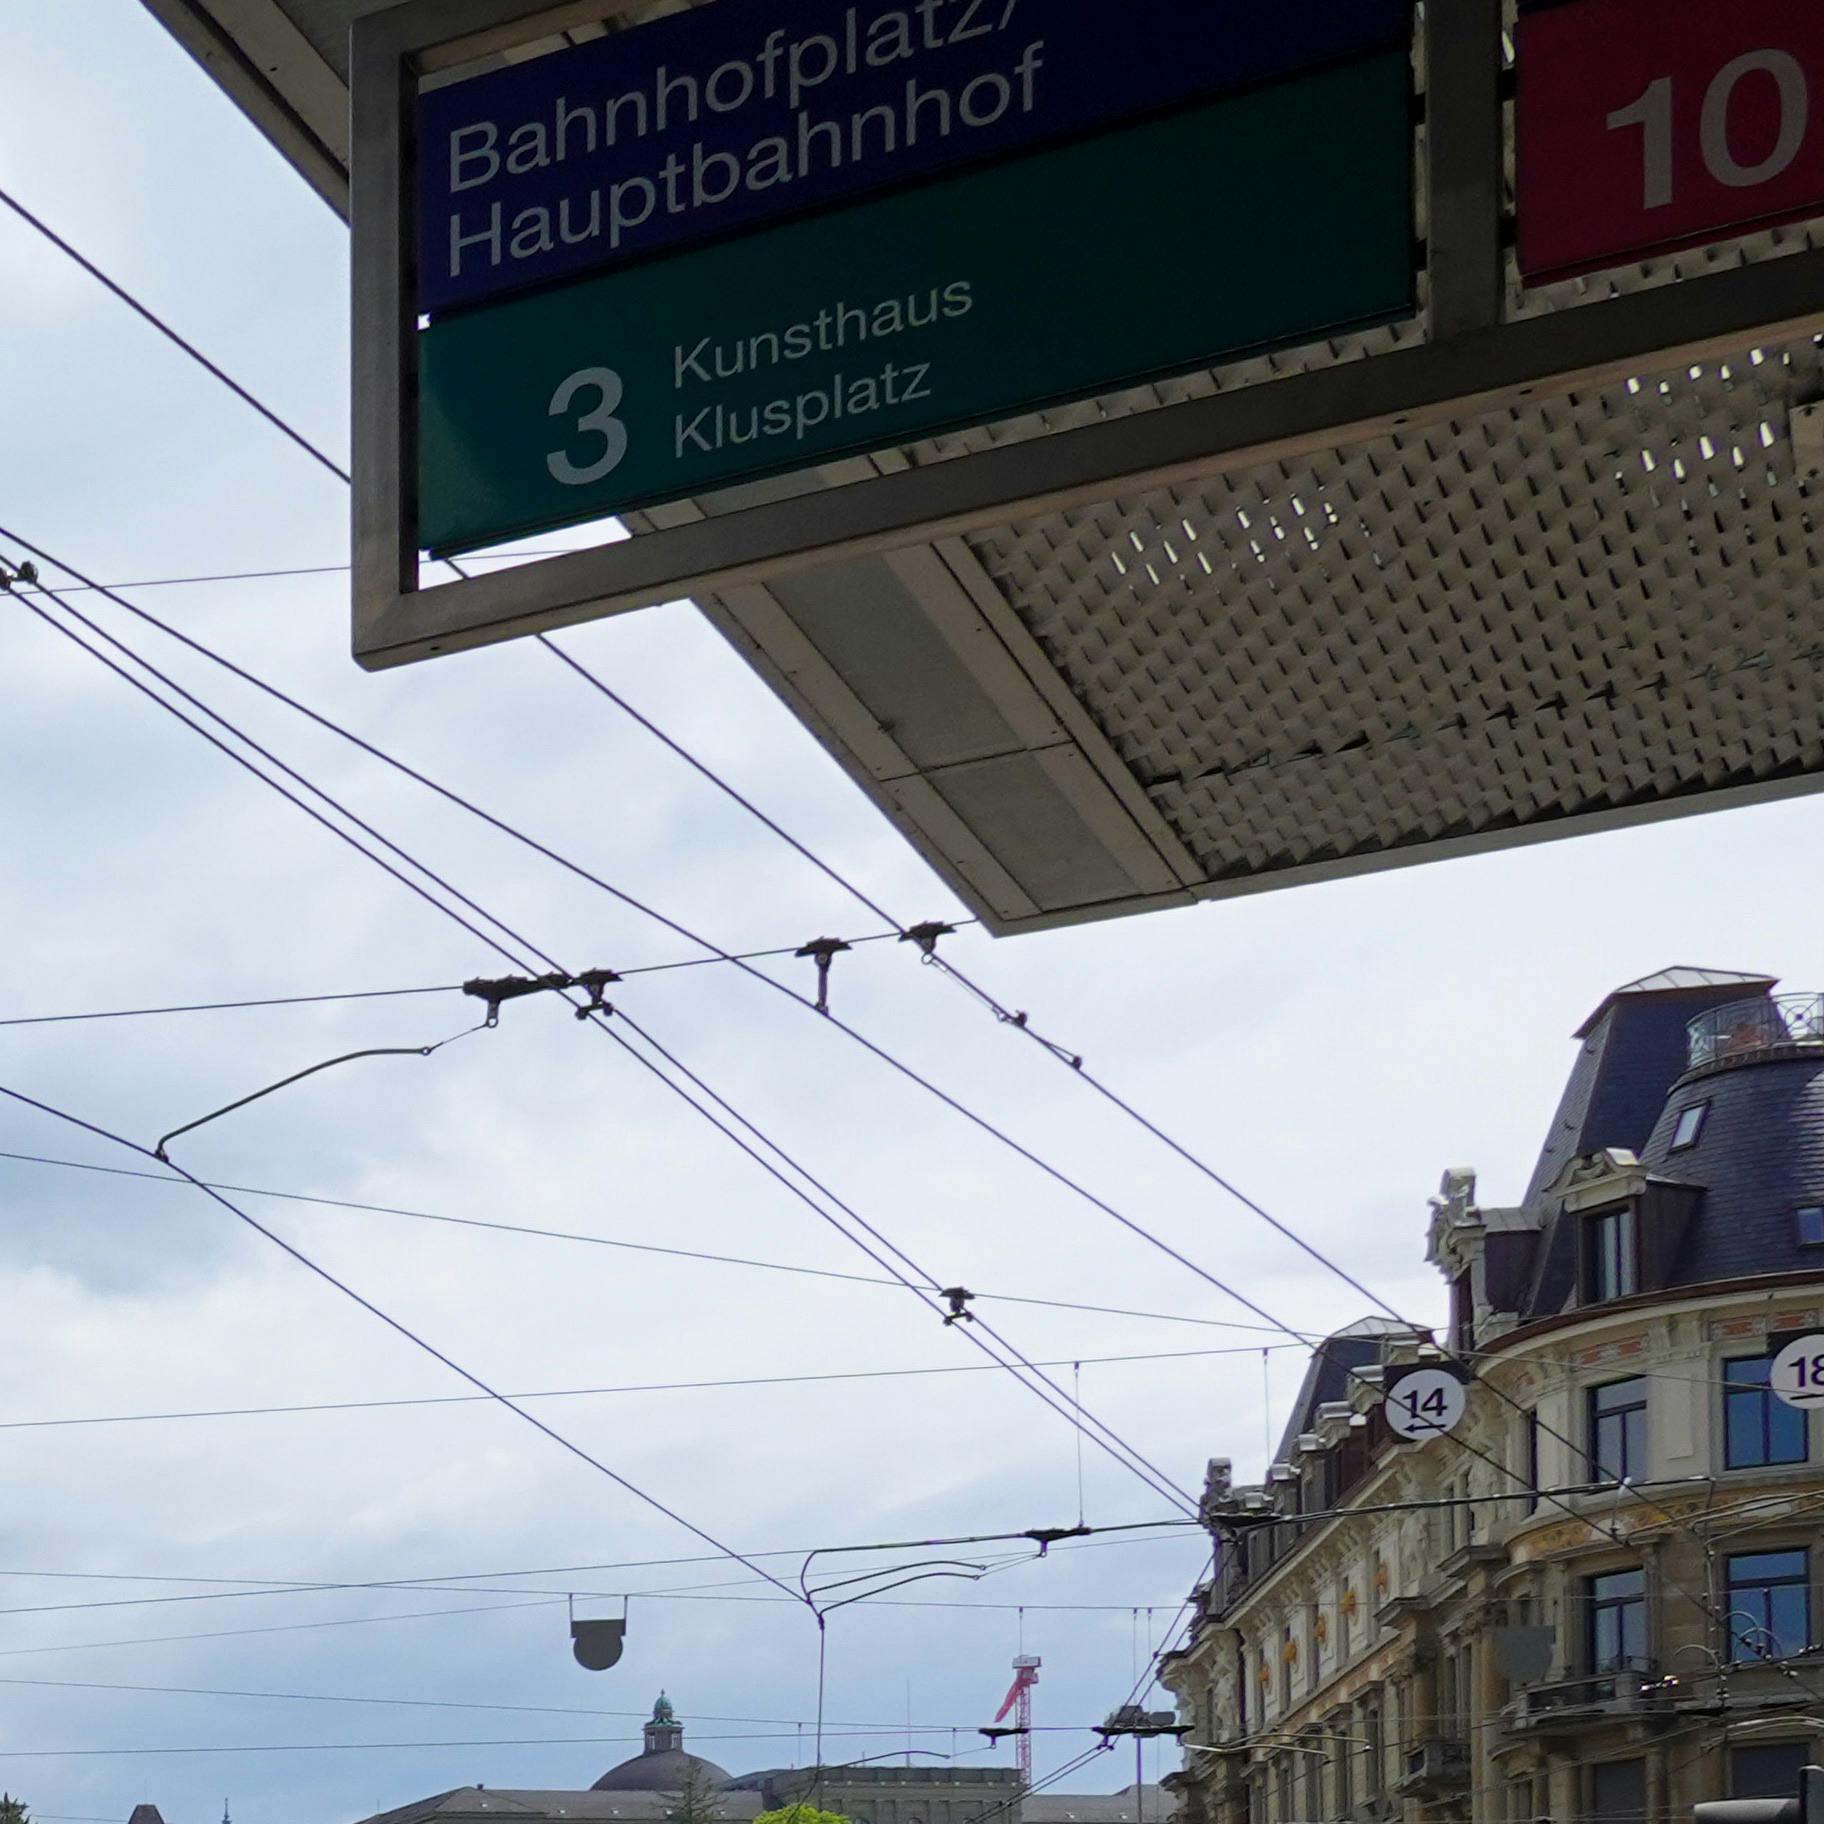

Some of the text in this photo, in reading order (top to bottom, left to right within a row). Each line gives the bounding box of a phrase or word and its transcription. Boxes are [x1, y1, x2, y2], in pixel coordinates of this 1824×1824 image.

[449, 41, 1045, 277] Hauptbahnhof
[1606, 48, 1809, 210] 10
[673, 279, 974, 389] Kunsthaus
[545, 366, 629, 486] 3
[673, 359, 932, 459] Klusplatz
[1403, 1388, 1448, 1419] 14
[1787, 1353, 1824, 1388] 18
